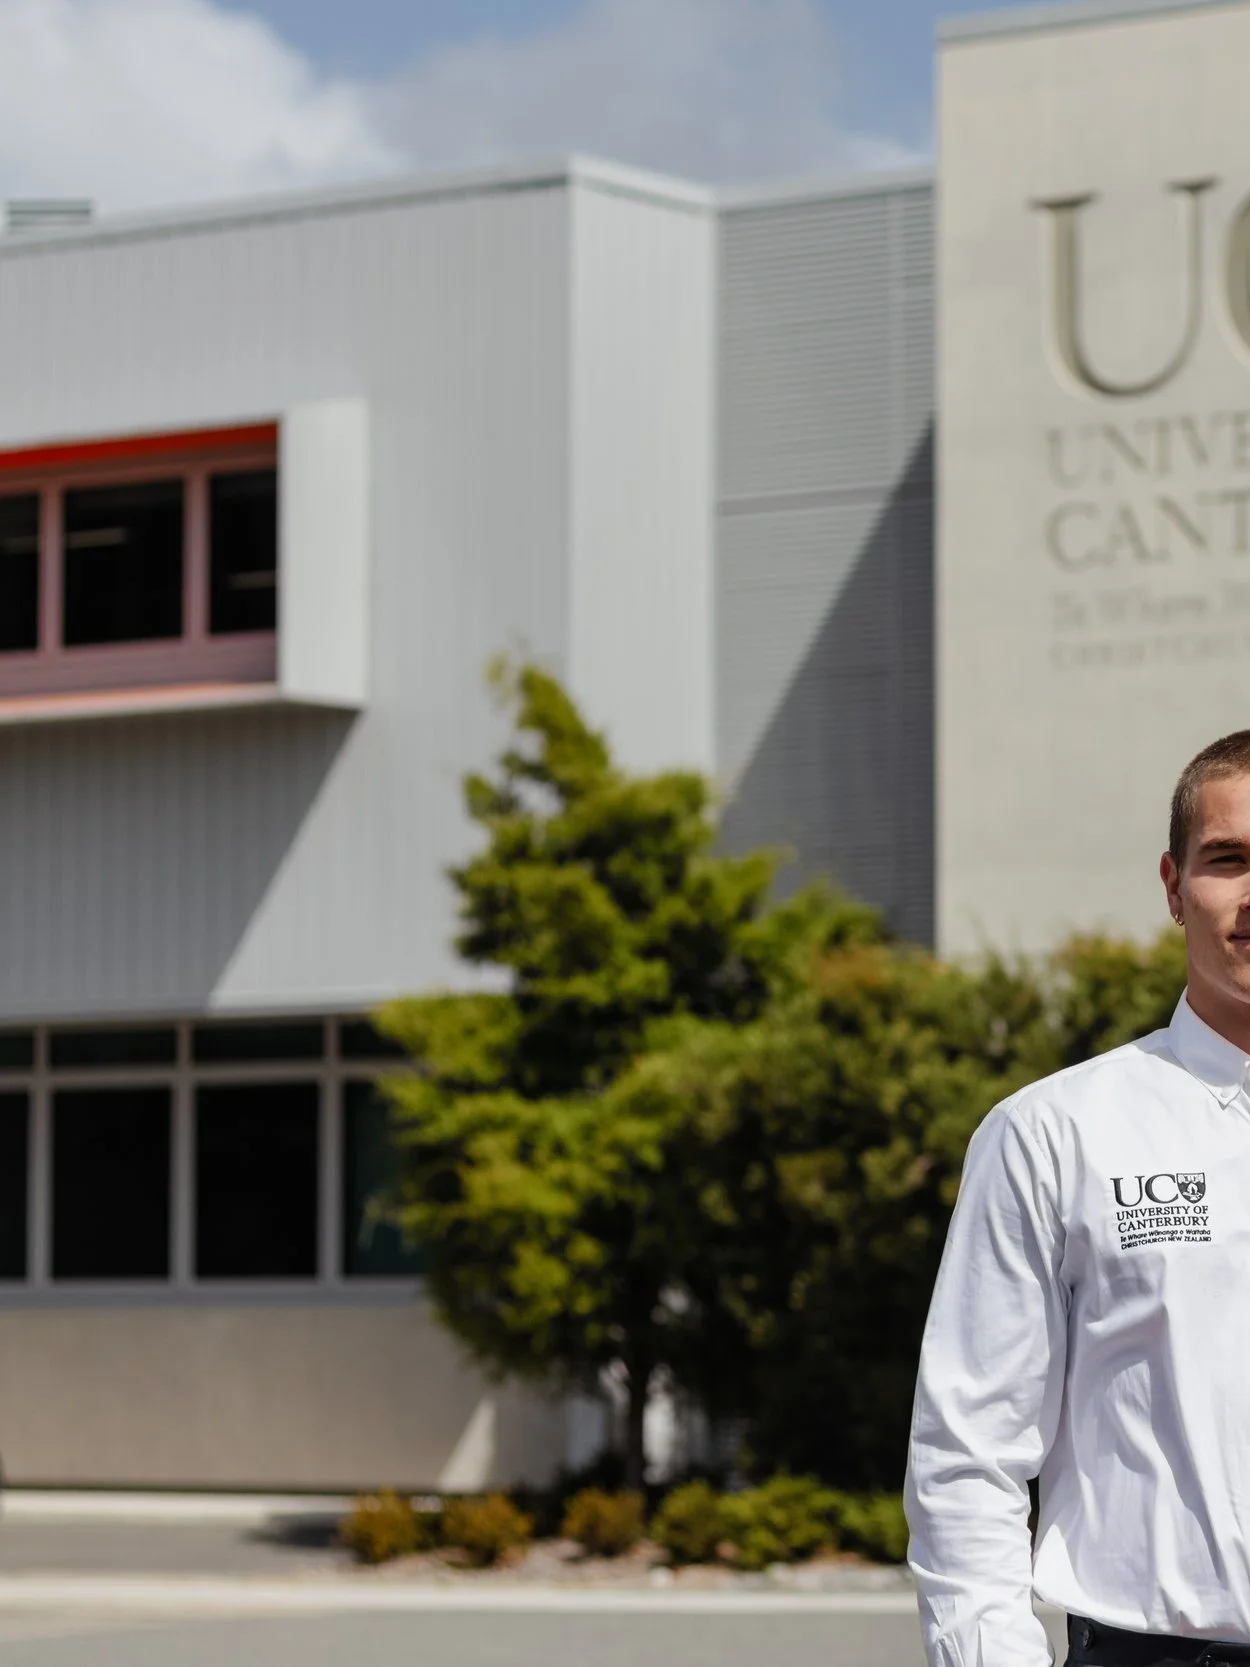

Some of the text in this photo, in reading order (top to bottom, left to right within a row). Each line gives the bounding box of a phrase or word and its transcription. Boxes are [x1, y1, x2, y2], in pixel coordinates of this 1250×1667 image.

[1110, 1174, 1178, 1207] UC
[1117, 1205, 1208, 1221] UNIVERSITY OF
[1118, 1216, 1209, 1233] CANTERBURY
[1121, 1237, 1167, 1250] CHRISTCHURCH
[1128, 1232, 1147, 1241] Whare
